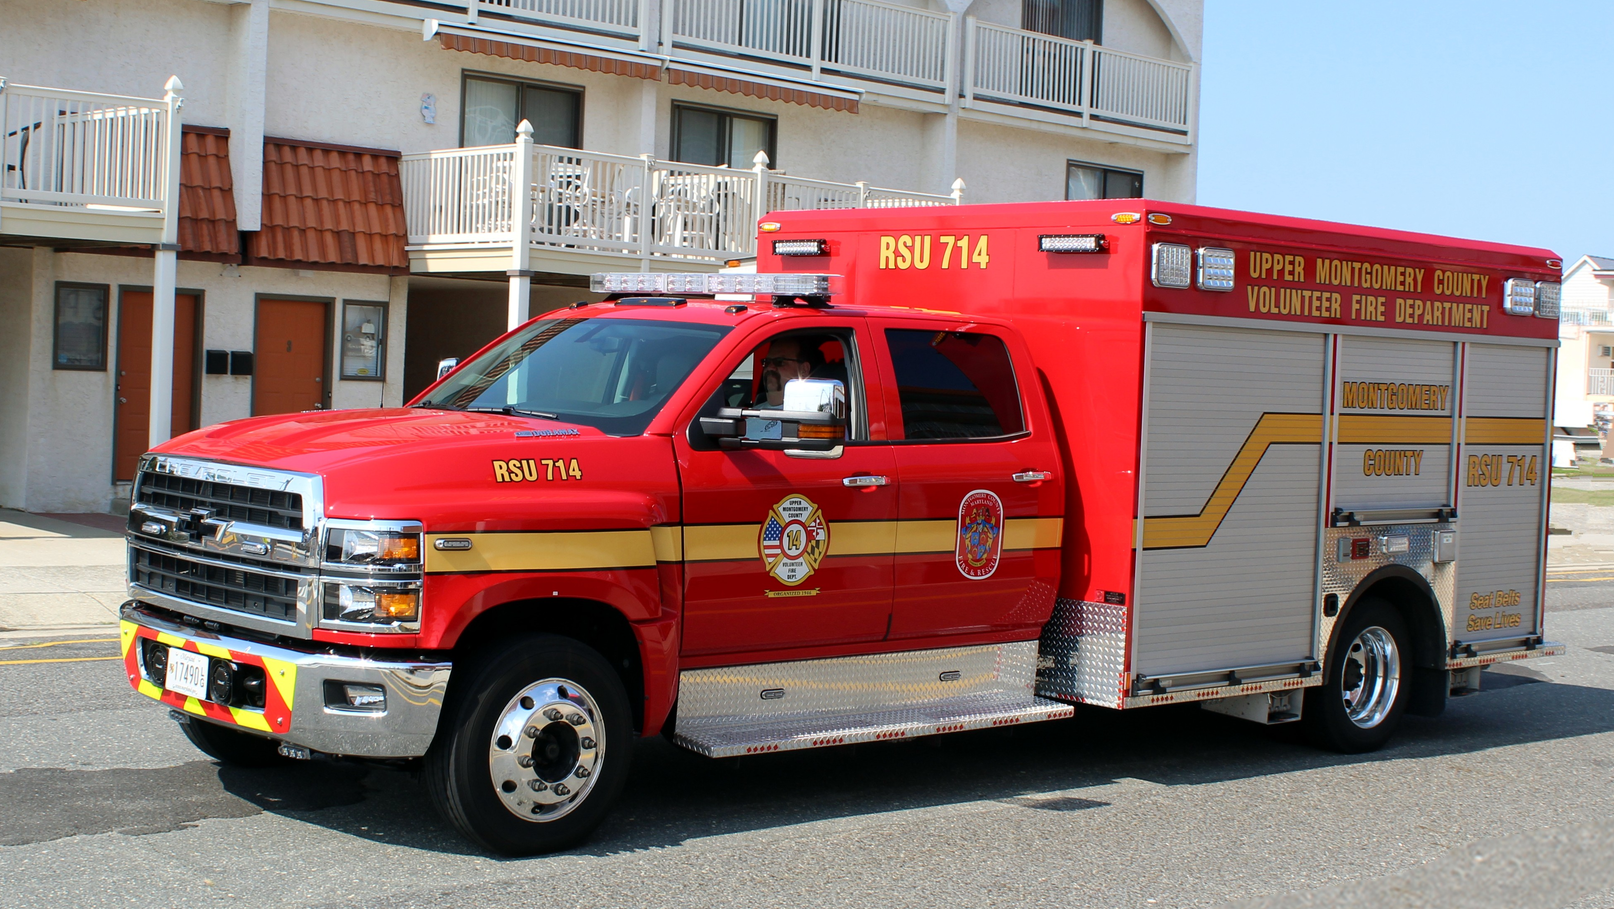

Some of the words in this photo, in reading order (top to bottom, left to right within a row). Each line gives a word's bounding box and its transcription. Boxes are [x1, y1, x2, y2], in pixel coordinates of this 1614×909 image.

[879, 234, 932, 270] RSU
[939, 234, 990, 270] 714
[1249, 251, 1305, 283] UPPER
[1315, 257, 1425, 294] MONTGOMERY
[1433, 269, 1490, 299] COUNTY
[1247, 285, 1341, 319] VOLUNTEER
[1351, 293, 1387, 323] FIRE
[1395, 297, 1490, 330] DEPARTMENT
[1342, 381, 1450, 411] MONTGOMERY
[492, 458, 538, 483] RSU
[540, 457, 583, 481] 714
[1363, 448, 1424, 476] COUNTY
[1466, 453, 1503, 487] RSU
[1507, 454, 1538, 486] 714
[961, 493, 987, 515] MONTGOMERY
[987, 494, 1001, 515] COUNTY
[970, 499, 993, 507] MARYLAND
[786, 530, 801, 551] 14
[958, 555, 969, 574] FIRE
[977, 554, 998, 576] RESCUE
[1469, 591, 1494, 611] Seat
[1494, 588, 1521, 608] Belts
[1466, 613, 1493, 632] Save
[1493, 611, 1521, 630] Lives
[174, 662, 199, 686] 17490
